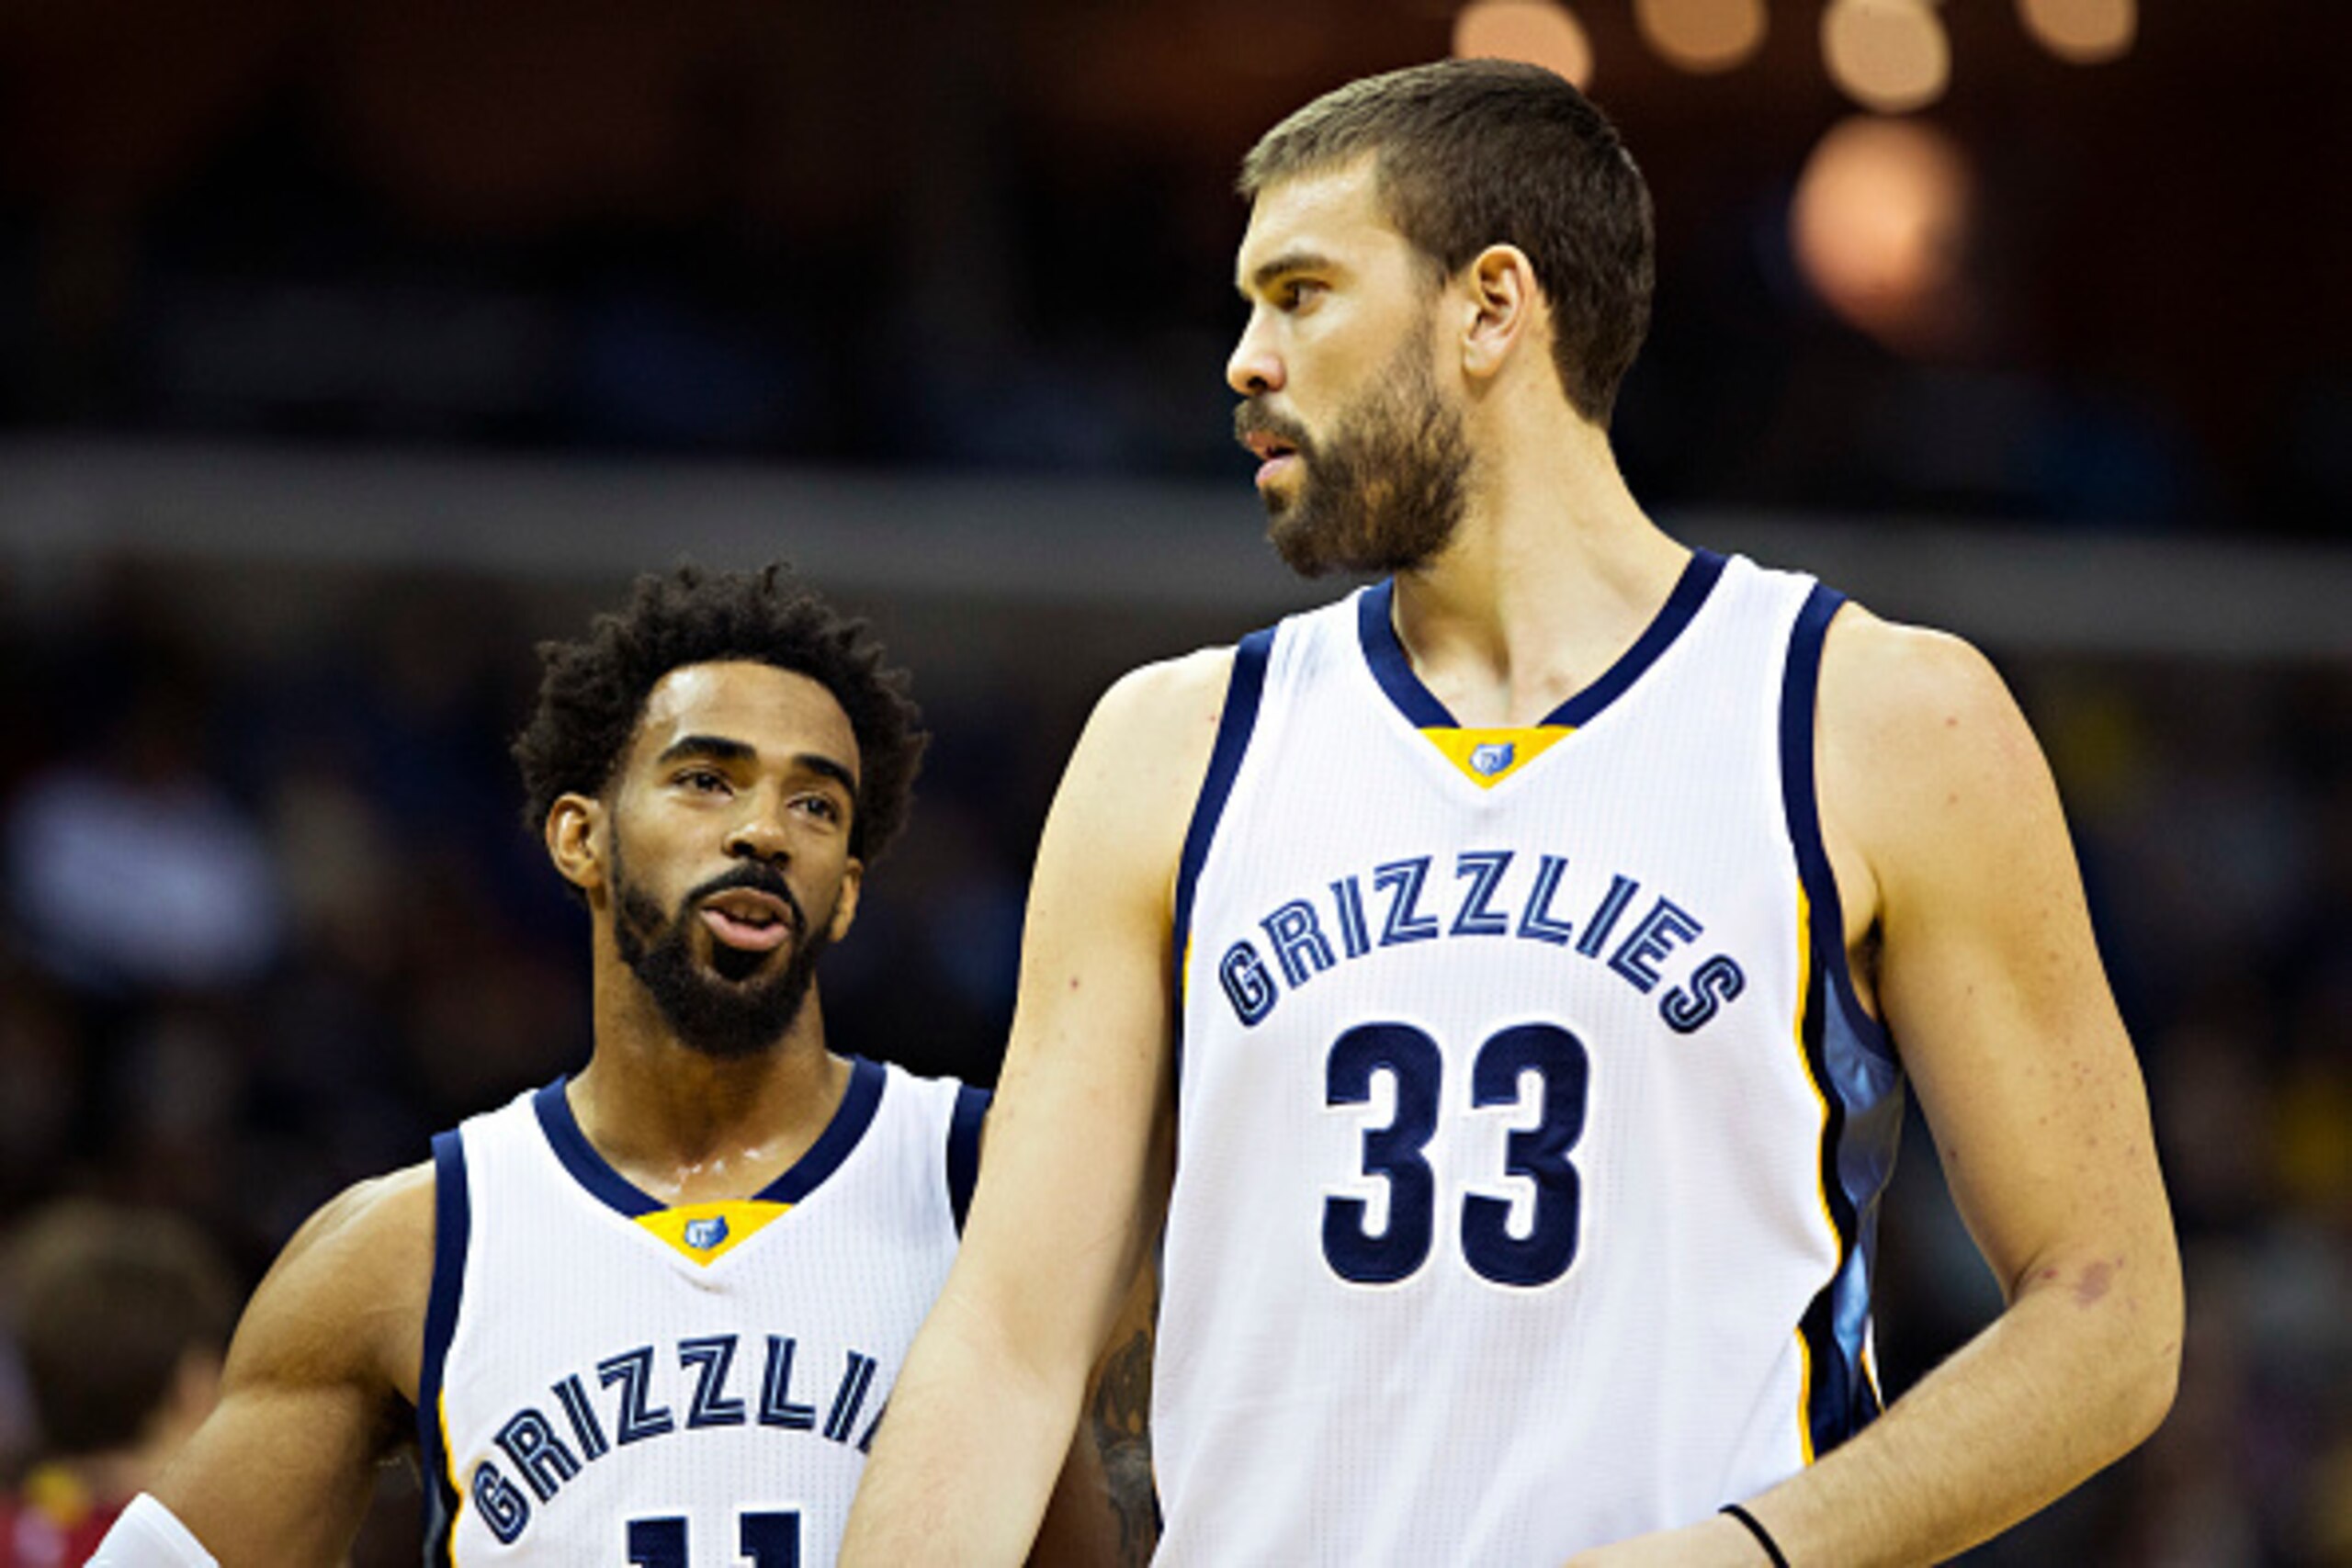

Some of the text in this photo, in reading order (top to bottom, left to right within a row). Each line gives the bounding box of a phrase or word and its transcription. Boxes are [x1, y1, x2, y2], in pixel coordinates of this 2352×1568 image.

[1218, 850, 1747, 1036] GRIZZLIES
[1320, 1021, 1590, 1288] 33
[470, 1333, 889, 1547] GRIZZLI
